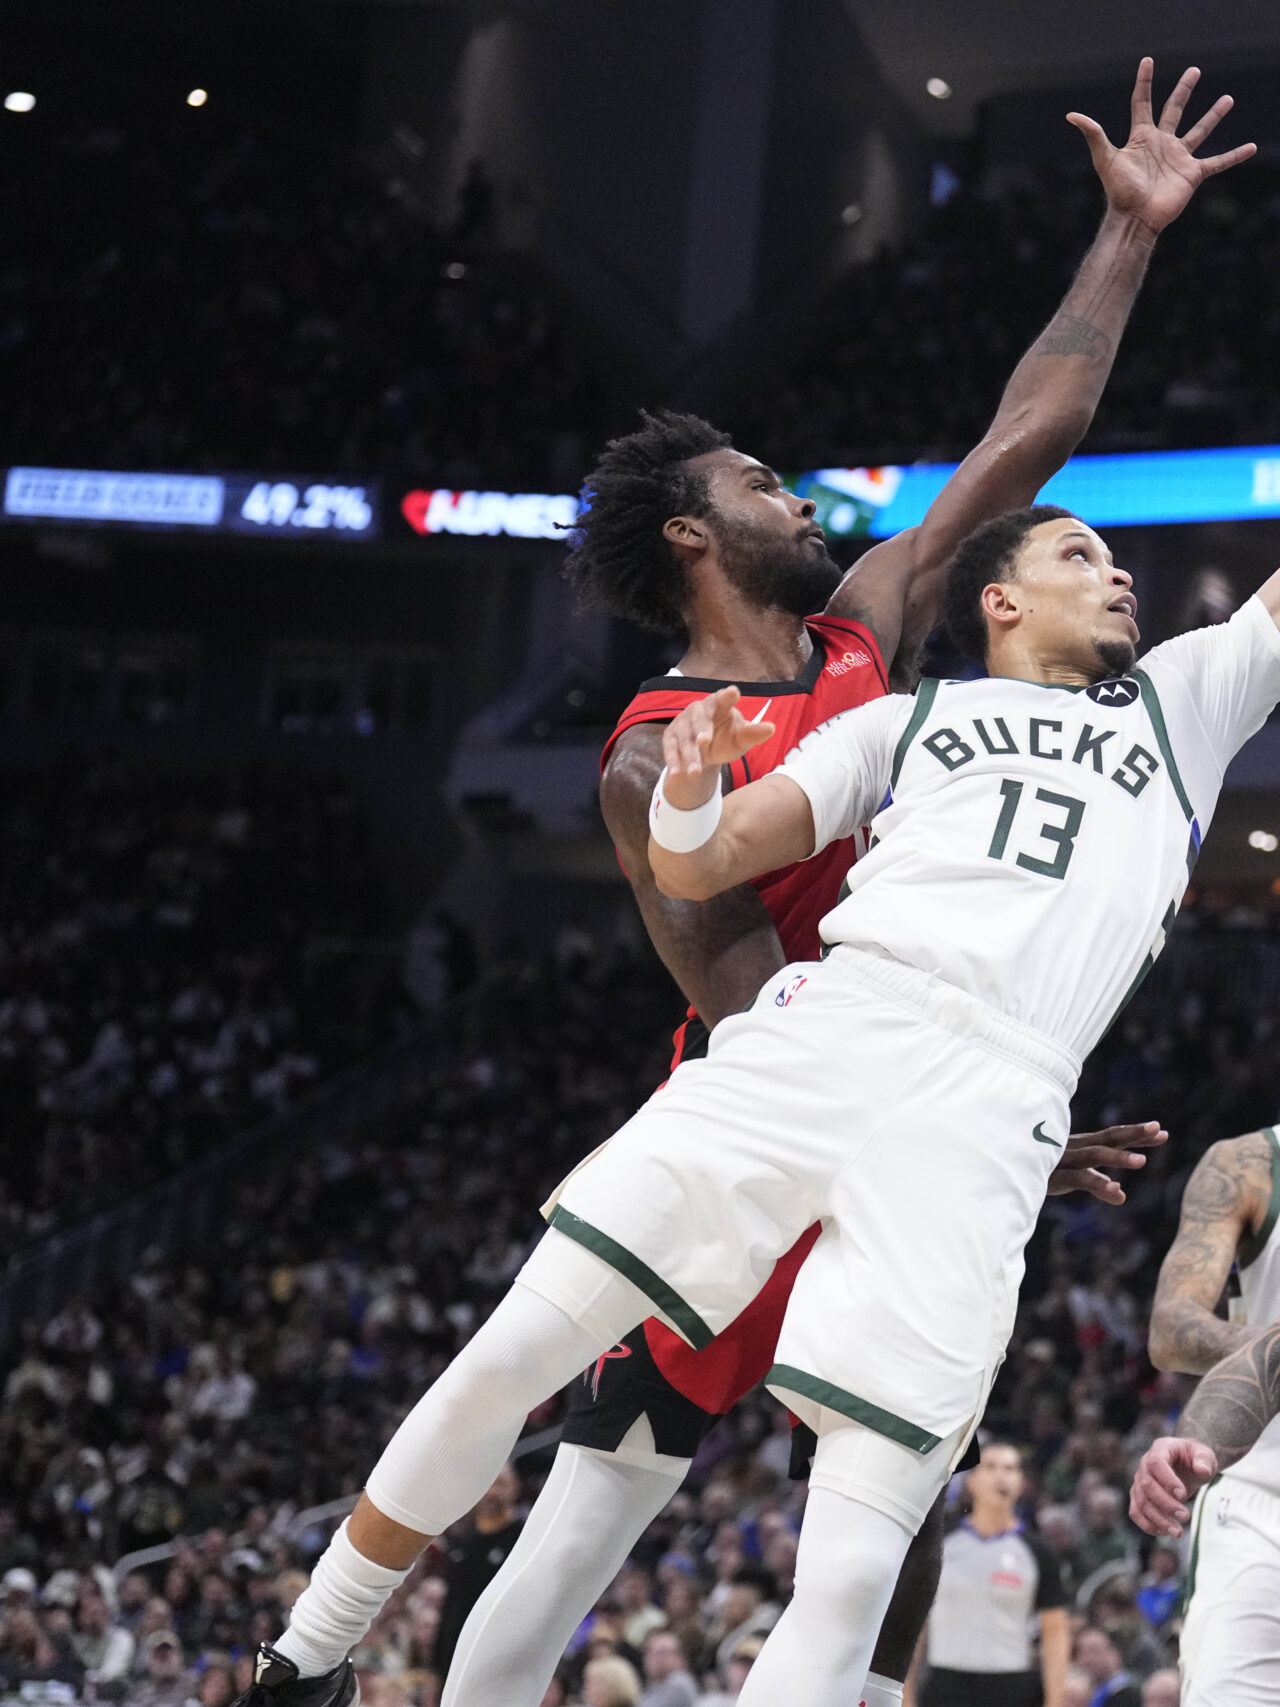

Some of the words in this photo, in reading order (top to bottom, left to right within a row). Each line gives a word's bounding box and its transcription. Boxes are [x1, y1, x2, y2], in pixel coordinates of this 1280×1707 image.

[241, 481, 372, 531] 49.2%
[921, 717, 1160, 798] BUCKS
[986, 778, 1087, 880] 13
